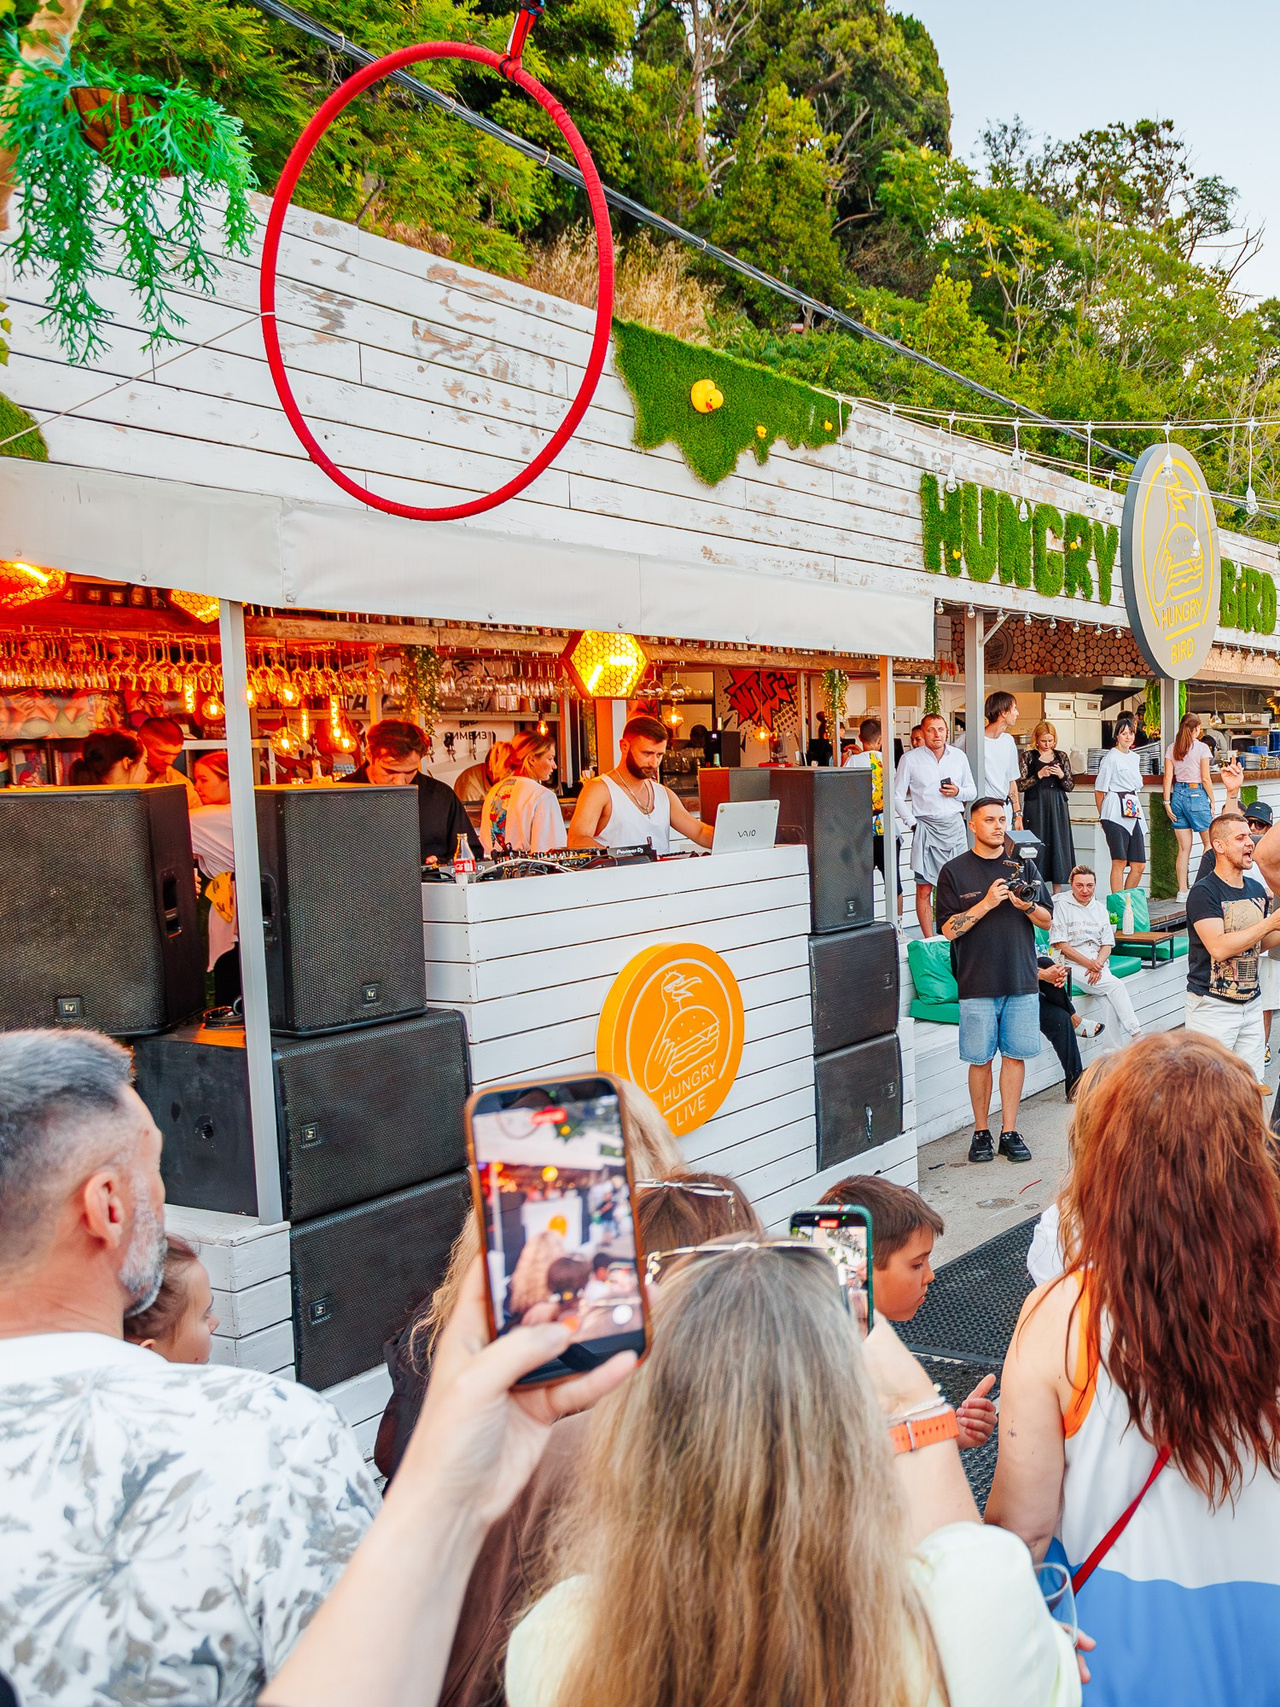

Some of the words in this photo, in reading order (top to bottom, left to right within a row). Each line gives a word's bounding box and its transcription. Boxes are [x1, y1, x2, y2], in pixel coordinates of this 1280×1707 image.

[920, 471, 1118, 606] HUNGRY
[1219, 558, 1277, 635] BIRD
[1161, 597, 1203, 631] HUNGRY
[1170, 640, 1195, 665] BIRD
[737, 829, 757, 838] VAIO
[662, 1058, 717, 1107] HUNGRY
[675, 1093, 707, 1127] LIVE
